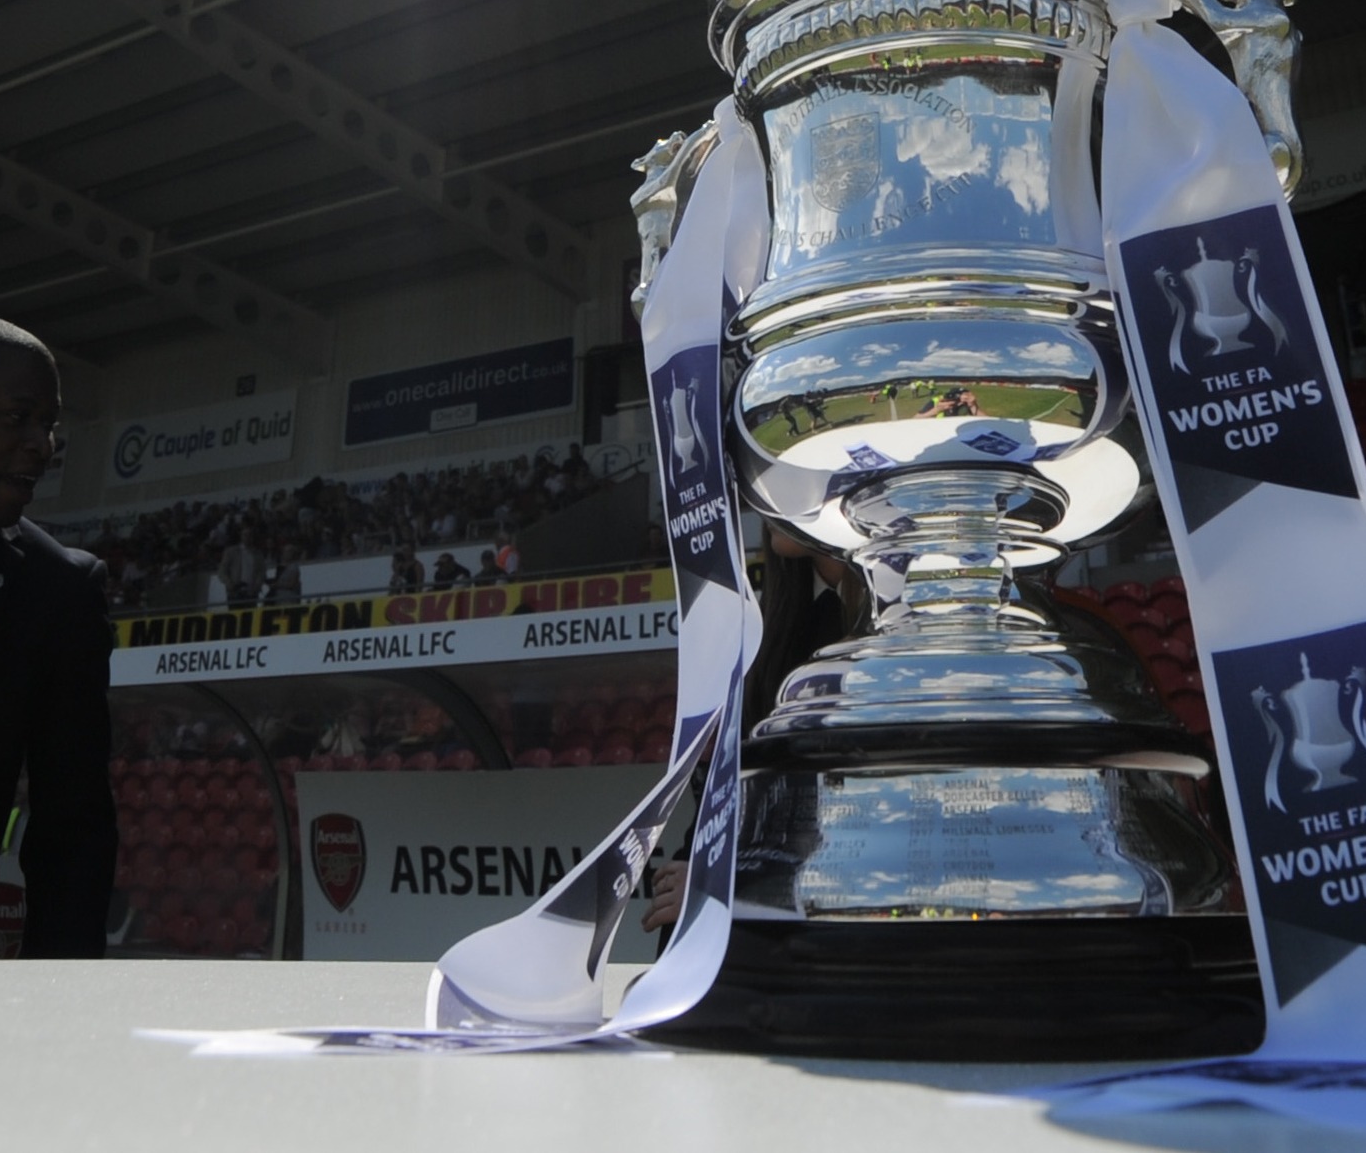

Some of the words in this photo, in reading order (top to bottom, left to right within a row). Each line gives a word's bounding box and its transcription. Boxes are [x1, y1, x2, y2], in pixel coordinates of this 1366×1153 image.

[352, 360, 568, 413] www.onecalldirect.co.uk
[1202, 372, 1242, 393] THE
[1246, 366, 1272, 385] FA
[1168, 379, 1322, 433] WOMEN'S
[153, 425, 216, 459] Couple
[221, 419, 242, 445] of
[247, 410, 292, 444] Quid
[1224, 421, 1280, 450] CUP
[678, 486, 696, 505] THE
[696, 482, 707, 497] FA
[670, 496, 726, 539] WOMEN'S
[690, 530, 714, 554] CUP
[130, 599, 373, 647] MIDDLETON
[385, 587, 508, 625] SKIP
[519, 572, 653, 614] HIRE
[322, 634, 415, 663] ARSENAL
[419, 630, 456, 655] LFC
[524, 614, 633, 648] ARSENAL
[156, 650, 232, 675] ARSENAL
[236, 645, 269, 669] LFC
[317, 829, 359, 845] Arsenal
[1299, 811, 1342, 836] THE
